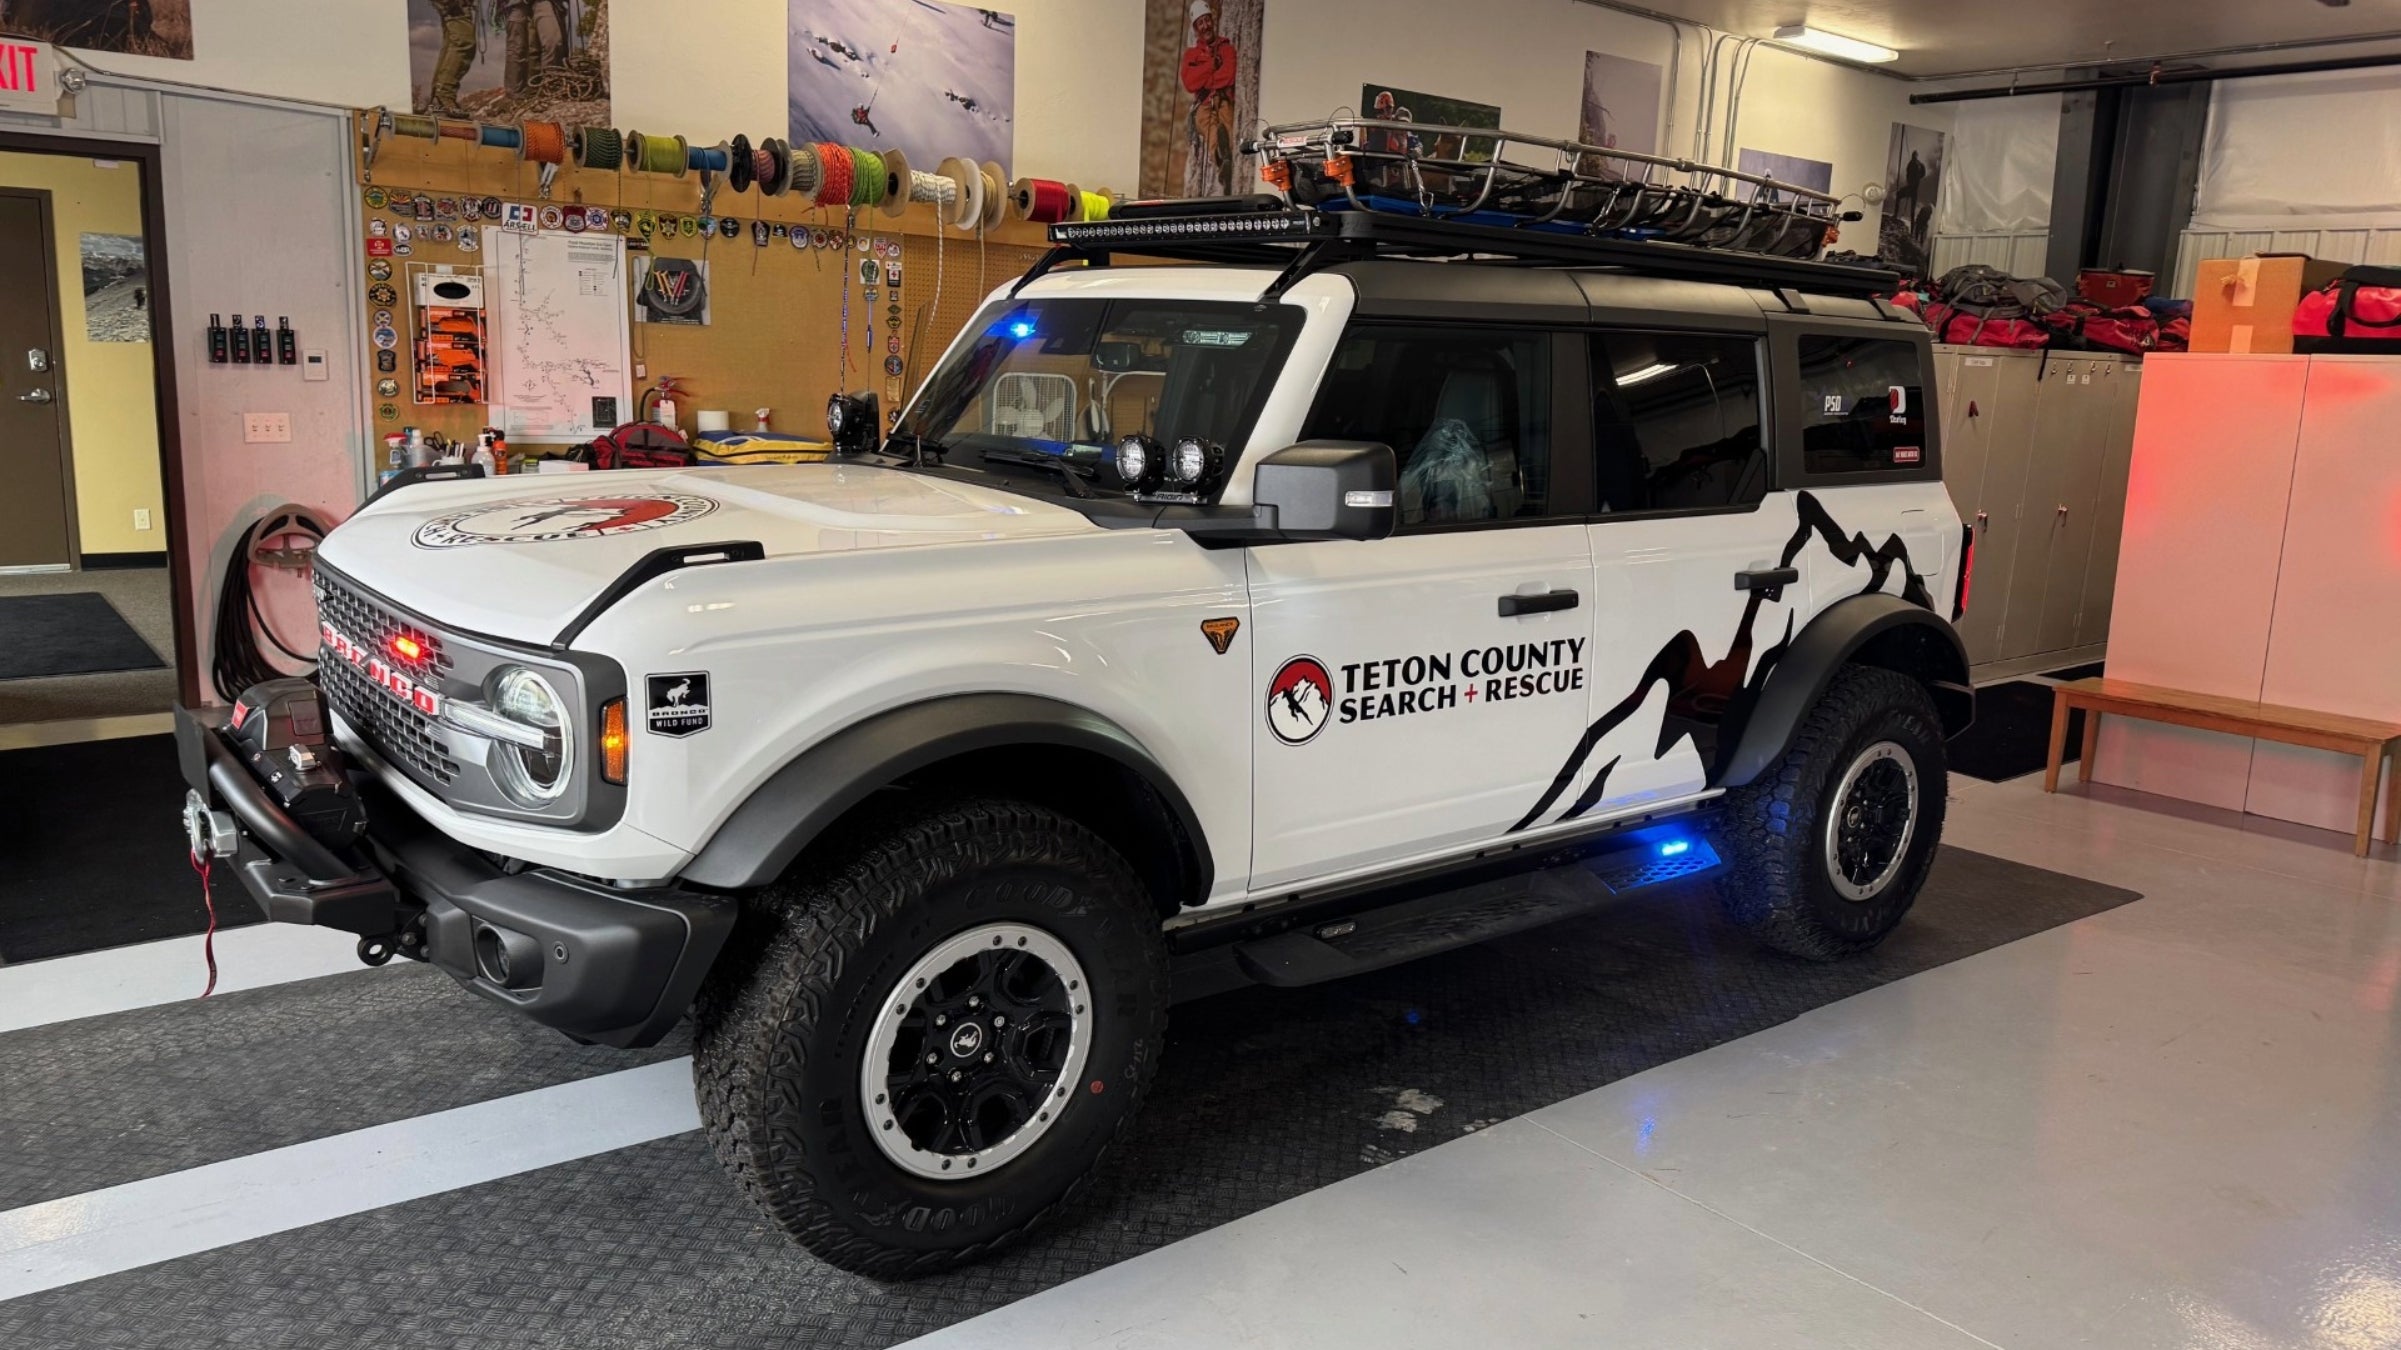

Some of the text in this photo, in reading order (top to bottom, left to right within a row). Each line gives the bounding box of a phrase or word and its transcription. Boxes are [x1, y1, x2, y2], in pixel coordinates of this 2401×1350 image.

[233, 315, 241, 327] 2
[321, 620, 441, 717] BRONCO
[1341, 636, 1587, 694] TETON COUNTY
[1339, 685, 1457, 724] SEARCH
[1485, 667, 1584, 703] RESCUE
[652, 709, 706, 717] BRONCO
[655, 717, 704, 728] WILD FUND
